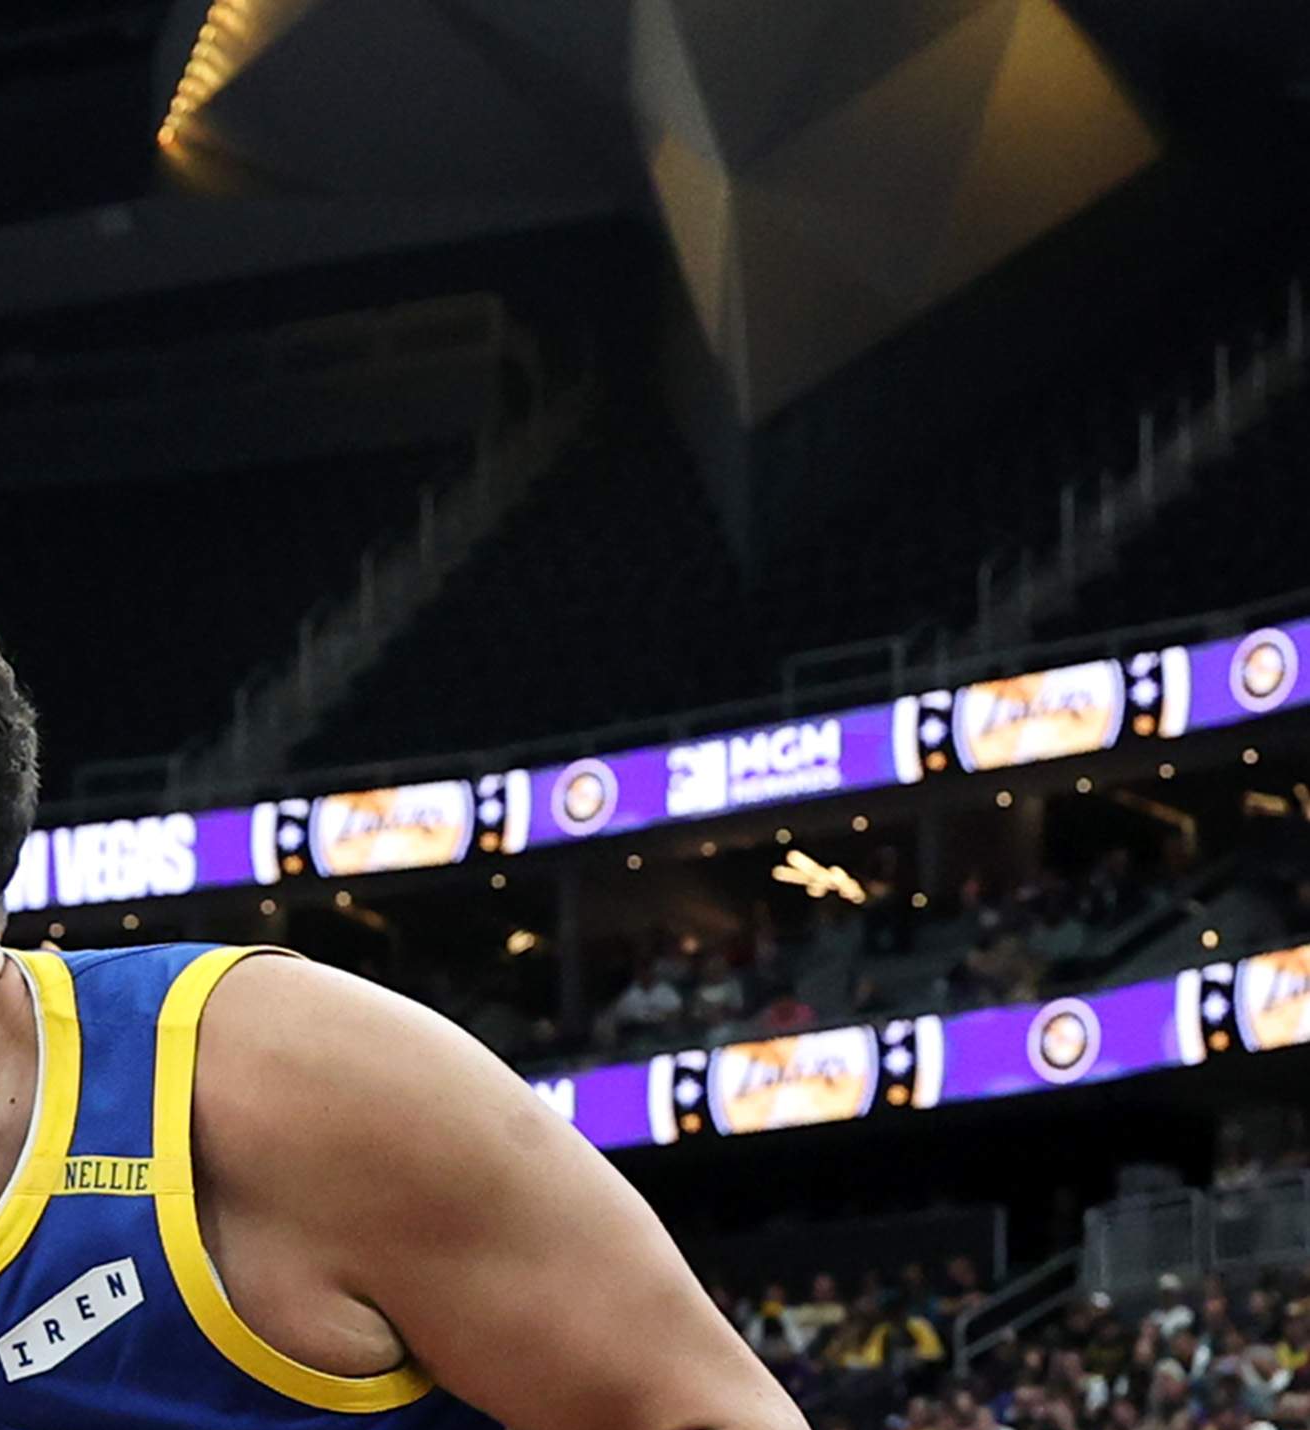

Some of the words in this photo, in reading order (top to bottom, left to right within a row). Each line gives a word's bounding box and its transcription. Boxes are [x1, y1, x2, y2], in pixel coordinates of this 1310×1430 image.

[52, 811, 197, 906] VEGAS
[64, 1161, 149, 1191] NELLIE
[12, 1271, 127, 1368] IREN
